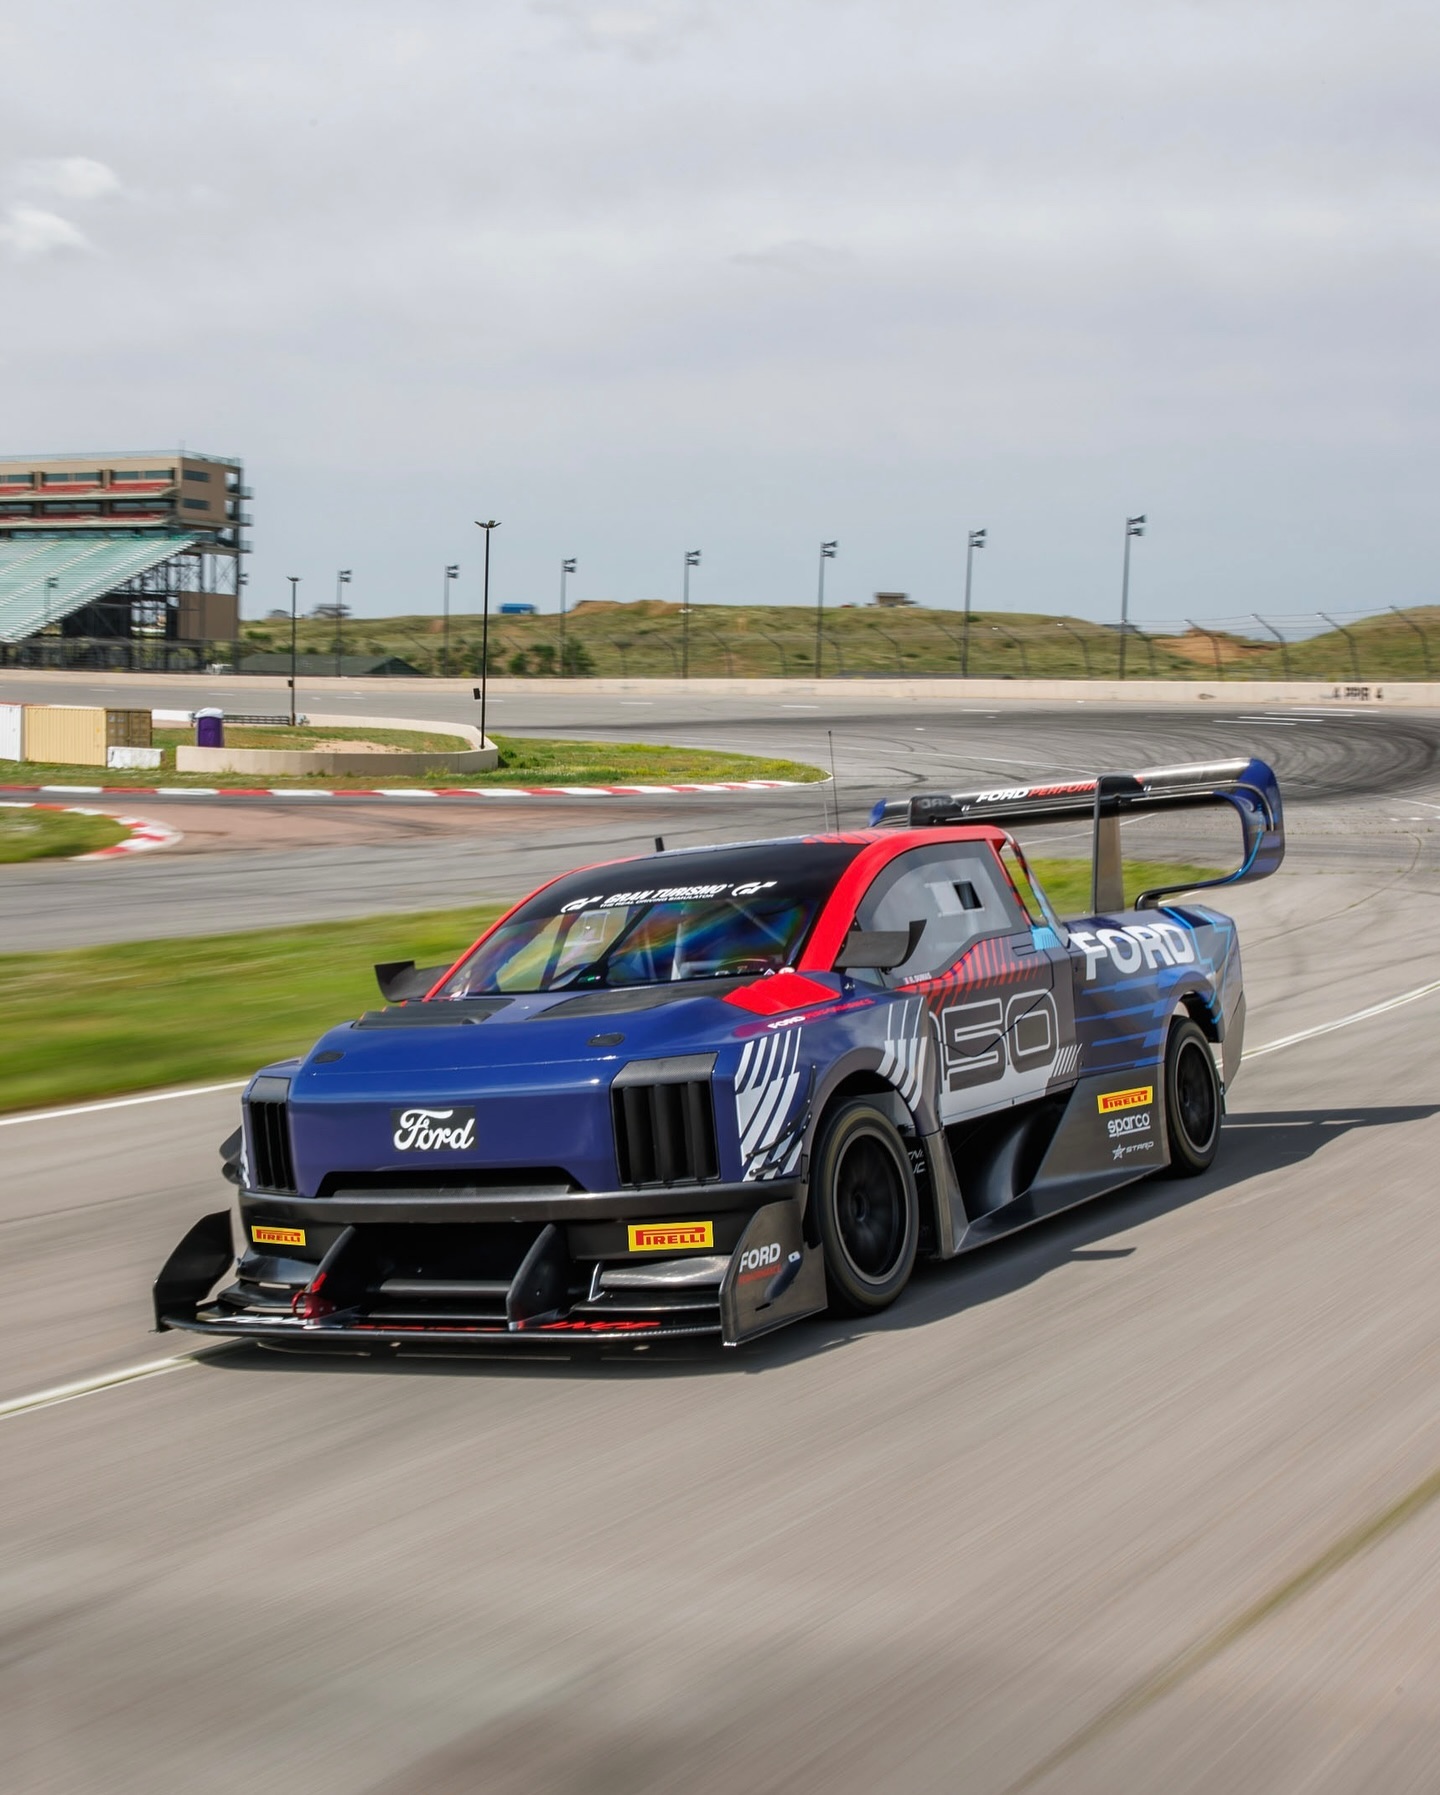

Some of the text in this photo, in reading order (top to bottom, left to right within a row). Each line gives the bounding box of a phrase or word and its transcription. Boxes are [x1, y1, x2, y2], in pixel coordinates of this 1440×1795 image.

[975, 788, 1029, 803] FORD
[604, 889, 655, 905] GRAN
[651, 884, 728, 900] TURISMO
[1068, 923, 1195, 980] FORD
[767, 1015, 806, 1029] FORD
[1102, 1090, 1148, 1109] PIRELLI
[393, 1109, 475, 1150] Ford
[1107, 1113, 1151, 1138] sparco
[256, 1228, 302, 1243] PIRELLI
[635, 1226, 706, 1246] PIRELLI
[739, 1243, 781, 1273] FORD
